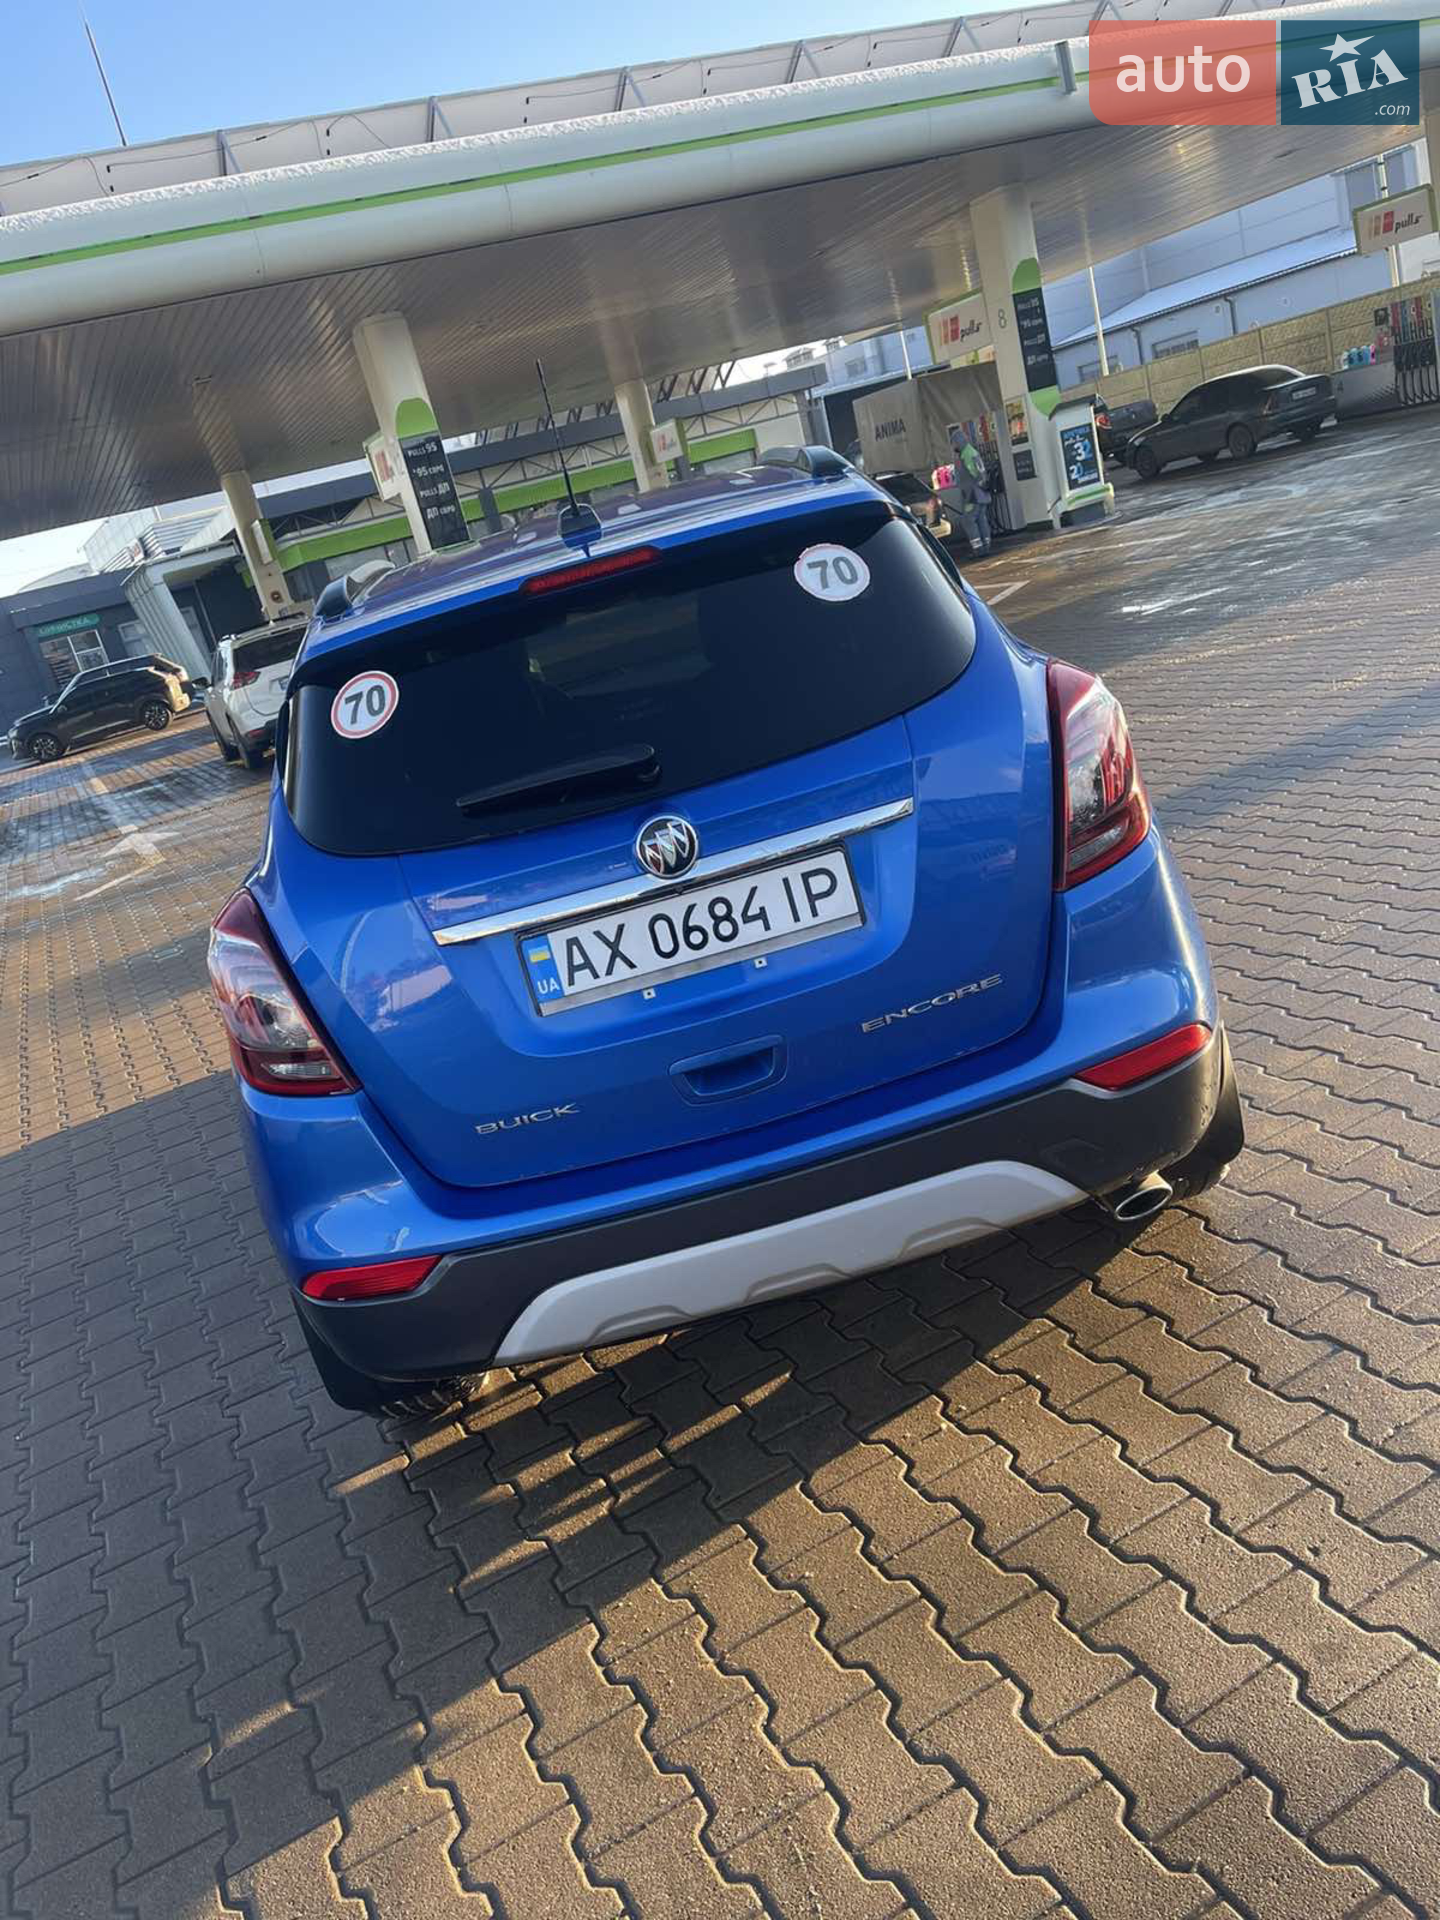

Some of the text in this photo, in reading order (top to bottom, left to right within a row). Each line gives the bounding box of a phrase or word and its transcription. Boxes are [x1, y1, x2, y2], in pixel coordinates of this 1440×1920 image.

[1395, 213, 1423, 233] pulls
[997, 308, 1007, 329] 8
[875, 418, 906, 442] ANIMA
[426, 442, 437, 452] 95
[806, 556, 858, 590] 70
[344, 684, 386, 725] 70
[565, 867, 838, 987] AX 0684 IP
[537, 978, 560, 995] UA
[861, 974, 1003, 1033] ENCORE
[475, 1102, 580, 1136] BUICK
